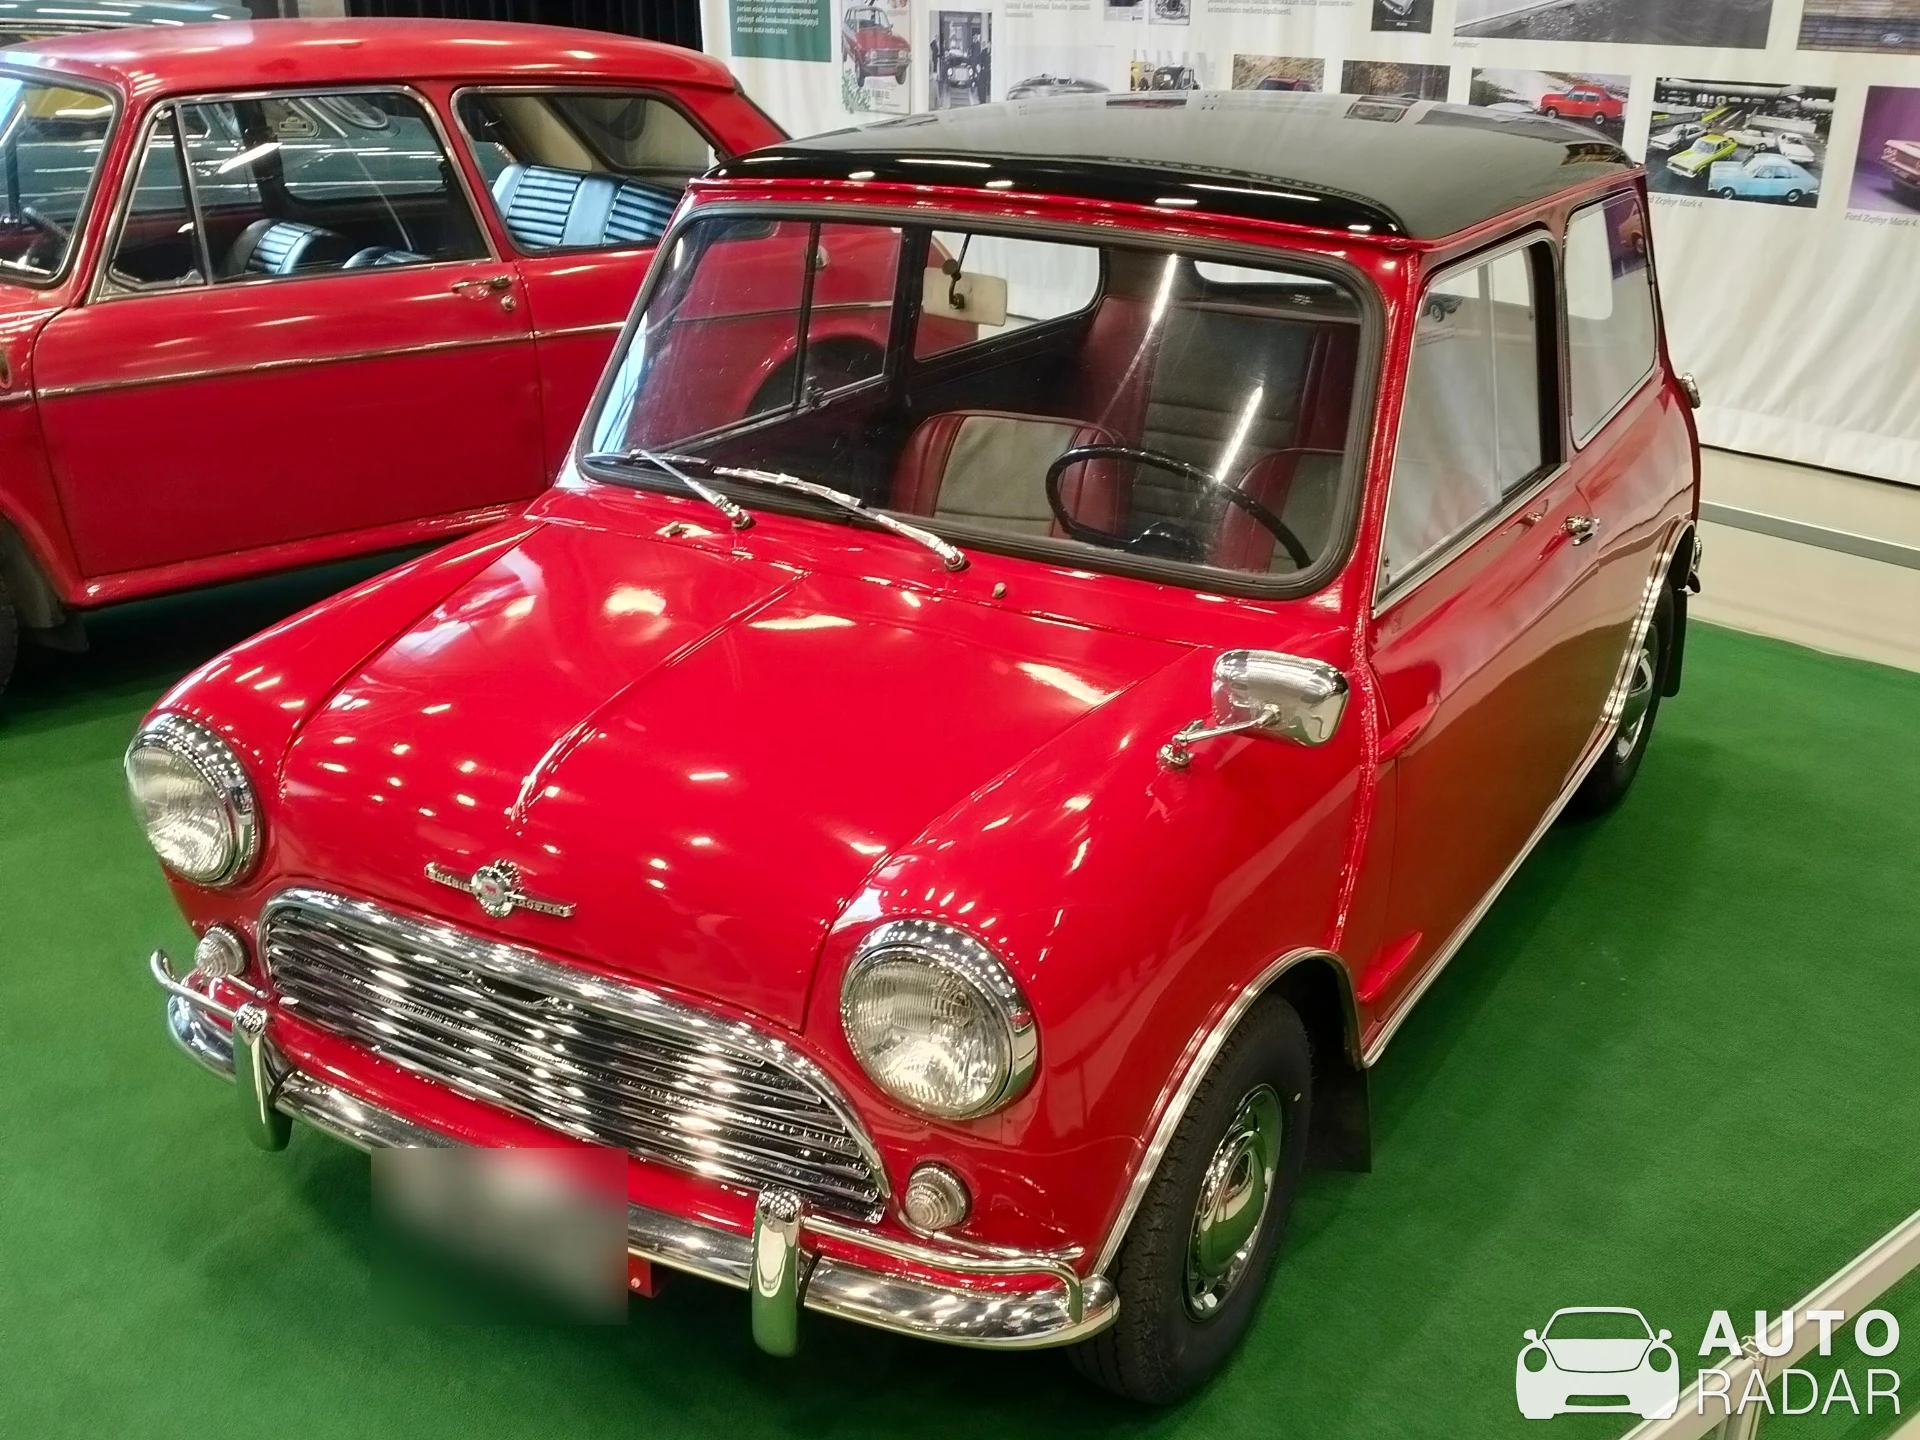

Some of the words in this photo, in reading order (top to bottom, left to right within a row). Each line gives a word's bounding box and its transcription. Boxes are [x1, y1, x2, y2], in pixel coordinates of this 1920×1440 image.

[1655, 197, 1678, 207] Zephyr
[1679, 199, 1696, 207] Mark
[1844, 212, 1862, 221] Ford
[1863, 214, 1888, 226] Zephyr
[1888, 217, 1910, 226] Mark
